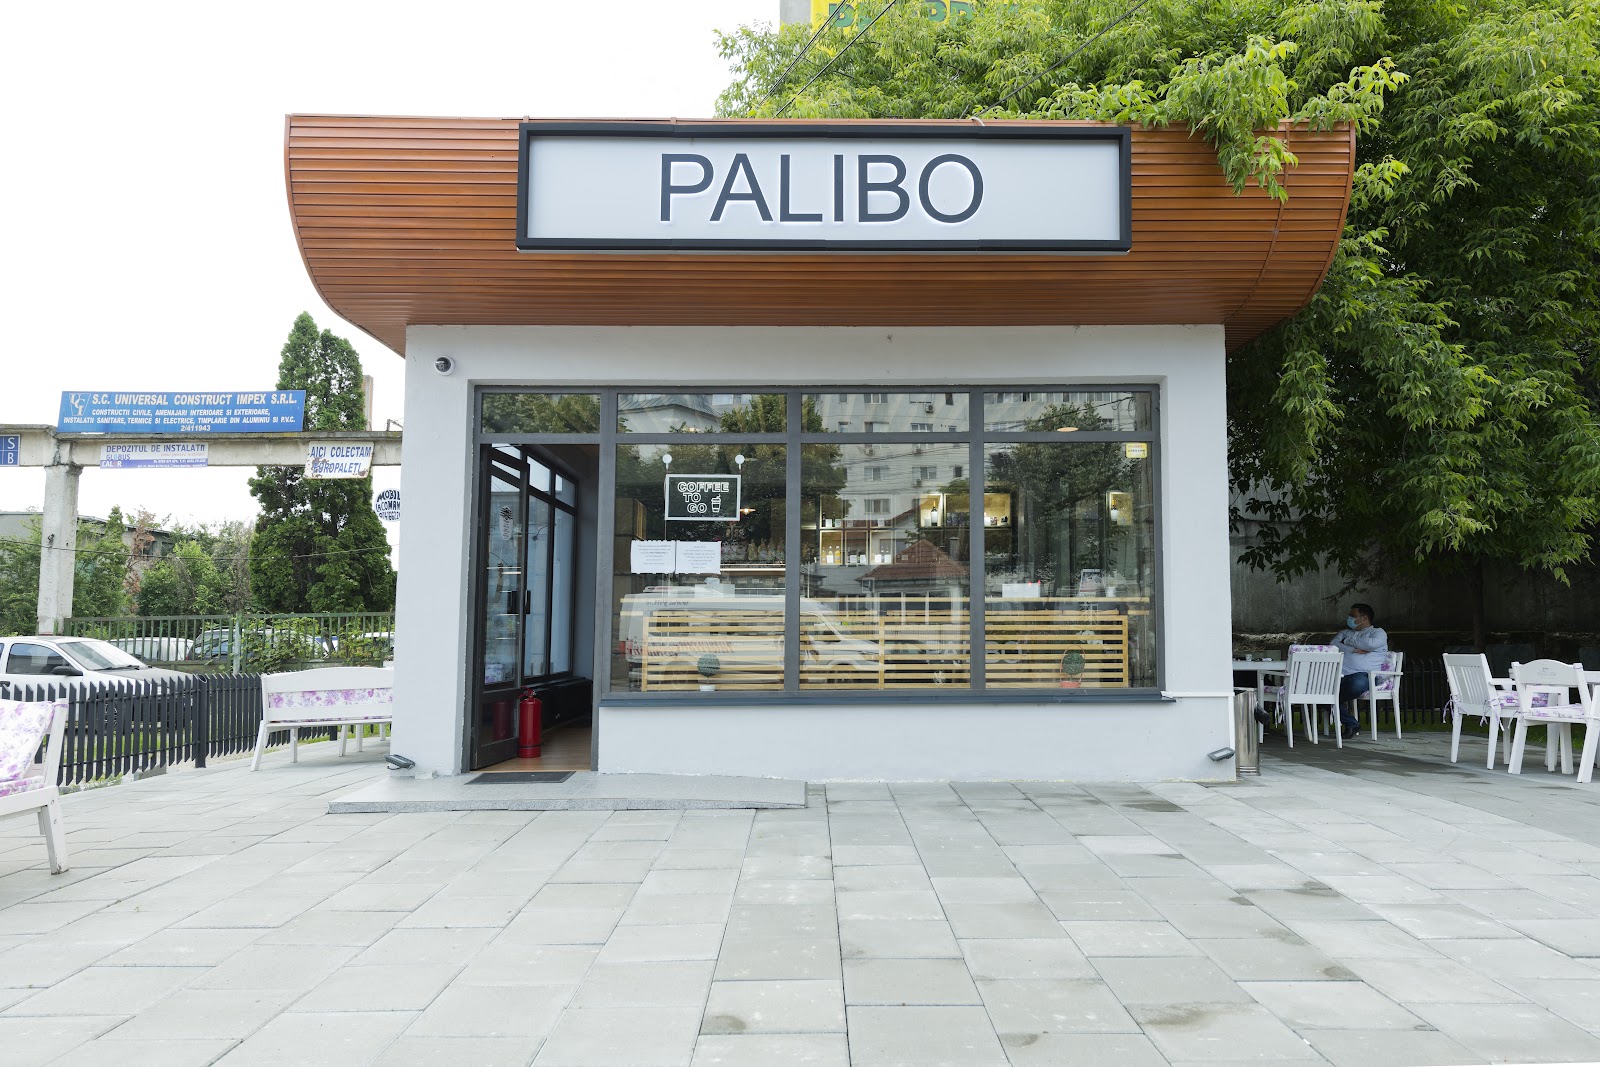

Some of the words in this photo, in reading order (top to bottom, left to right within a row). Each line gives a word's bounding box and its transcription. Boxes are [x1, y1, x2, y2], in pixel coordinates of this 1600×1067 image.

[660, 153, 984, 223] PALIBO
[92, 394, 110, 404] S.C.
[115, 394, 168, 405] UNIVERSAL
[174, 394, 232, 405] CONSTRUCT
[236, 394, 266, 404] IMPEX
[271, 393, 297, 404] S.R.L.
[234, 408, 271, 416] EXTERIOARE,
[96, 417, 126, 425] SANITARE,
[163, 417, 195, 425] ELECTRICE,
[7, 437, 15, 449] S
[310, 446, 327, 457] AICI
[330, 446, 371, 457] COLECTAM
[7, 452, 14, 464] B
[677, 481, 729, 493] COFFEE
[377, 489, 400, 502] MOBIL
[683, 492, 701, 503] TO
[687, 502, 707, 513] GO
